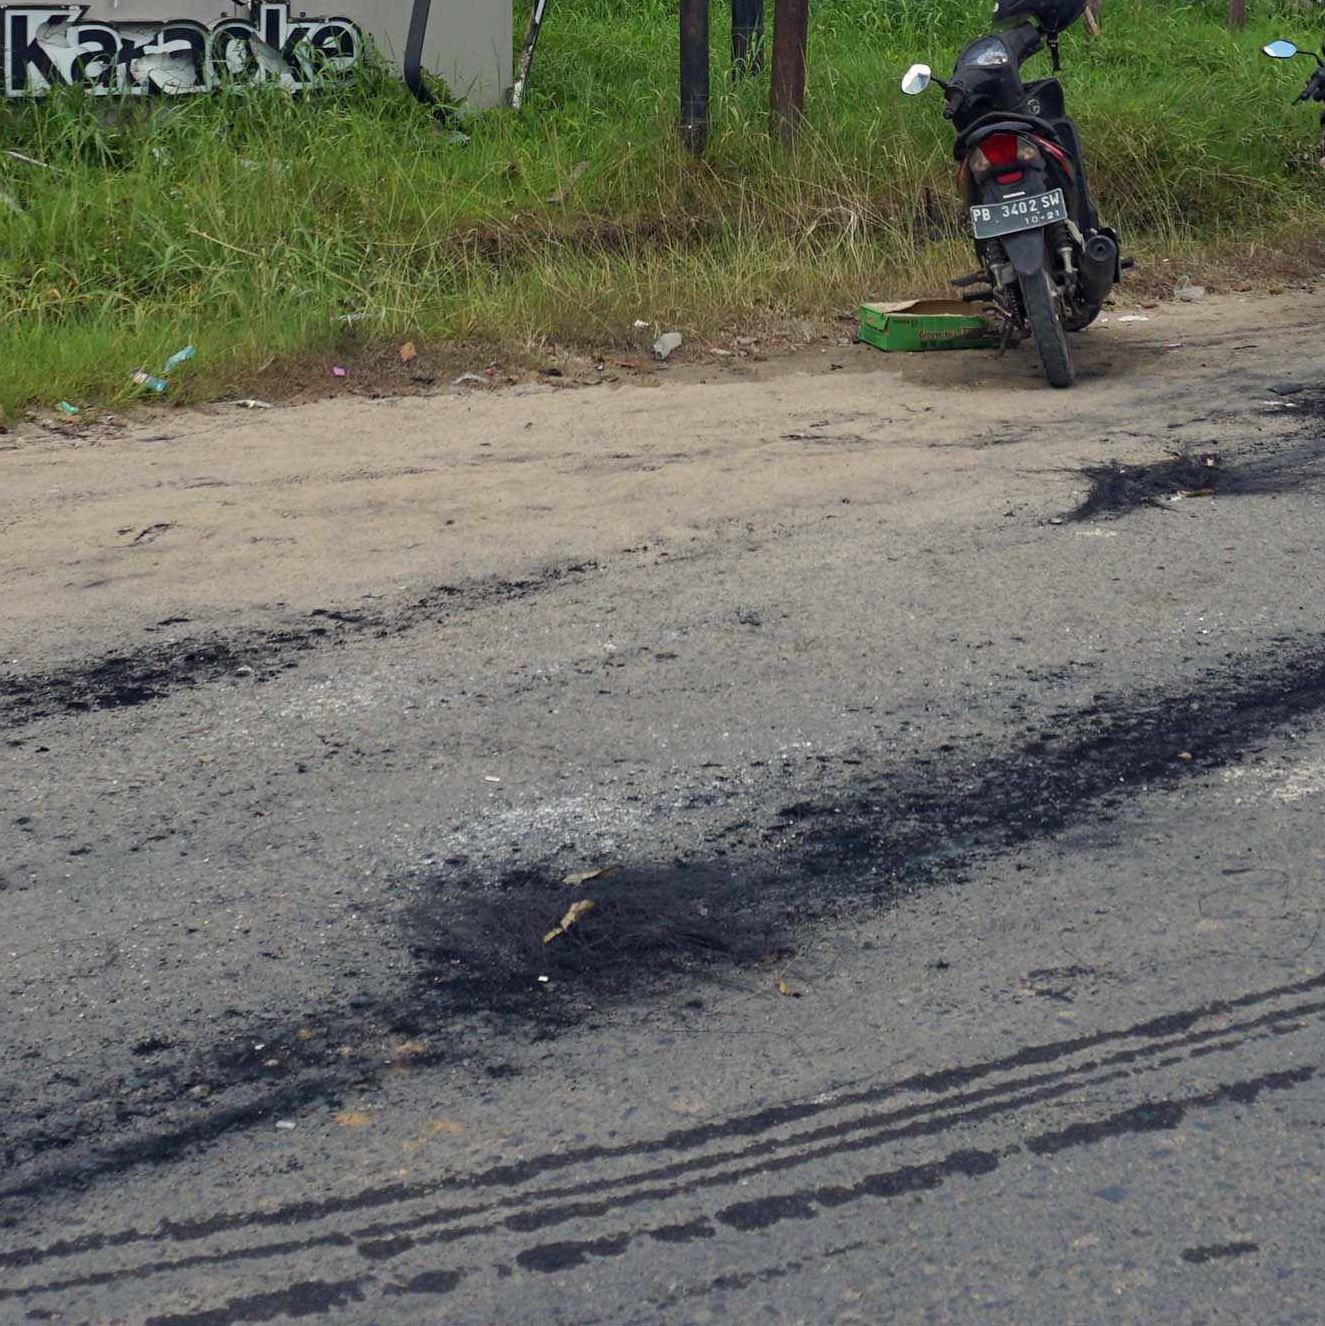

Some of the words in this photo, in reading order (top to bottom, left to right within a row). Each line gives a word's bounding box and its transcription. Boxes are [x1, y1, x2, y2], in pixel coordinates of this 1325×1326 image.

[973, 208, 991, 222] PB
[1001, 199, 1038, 217] 3402
[1041, 192, 1060, 208] SW
